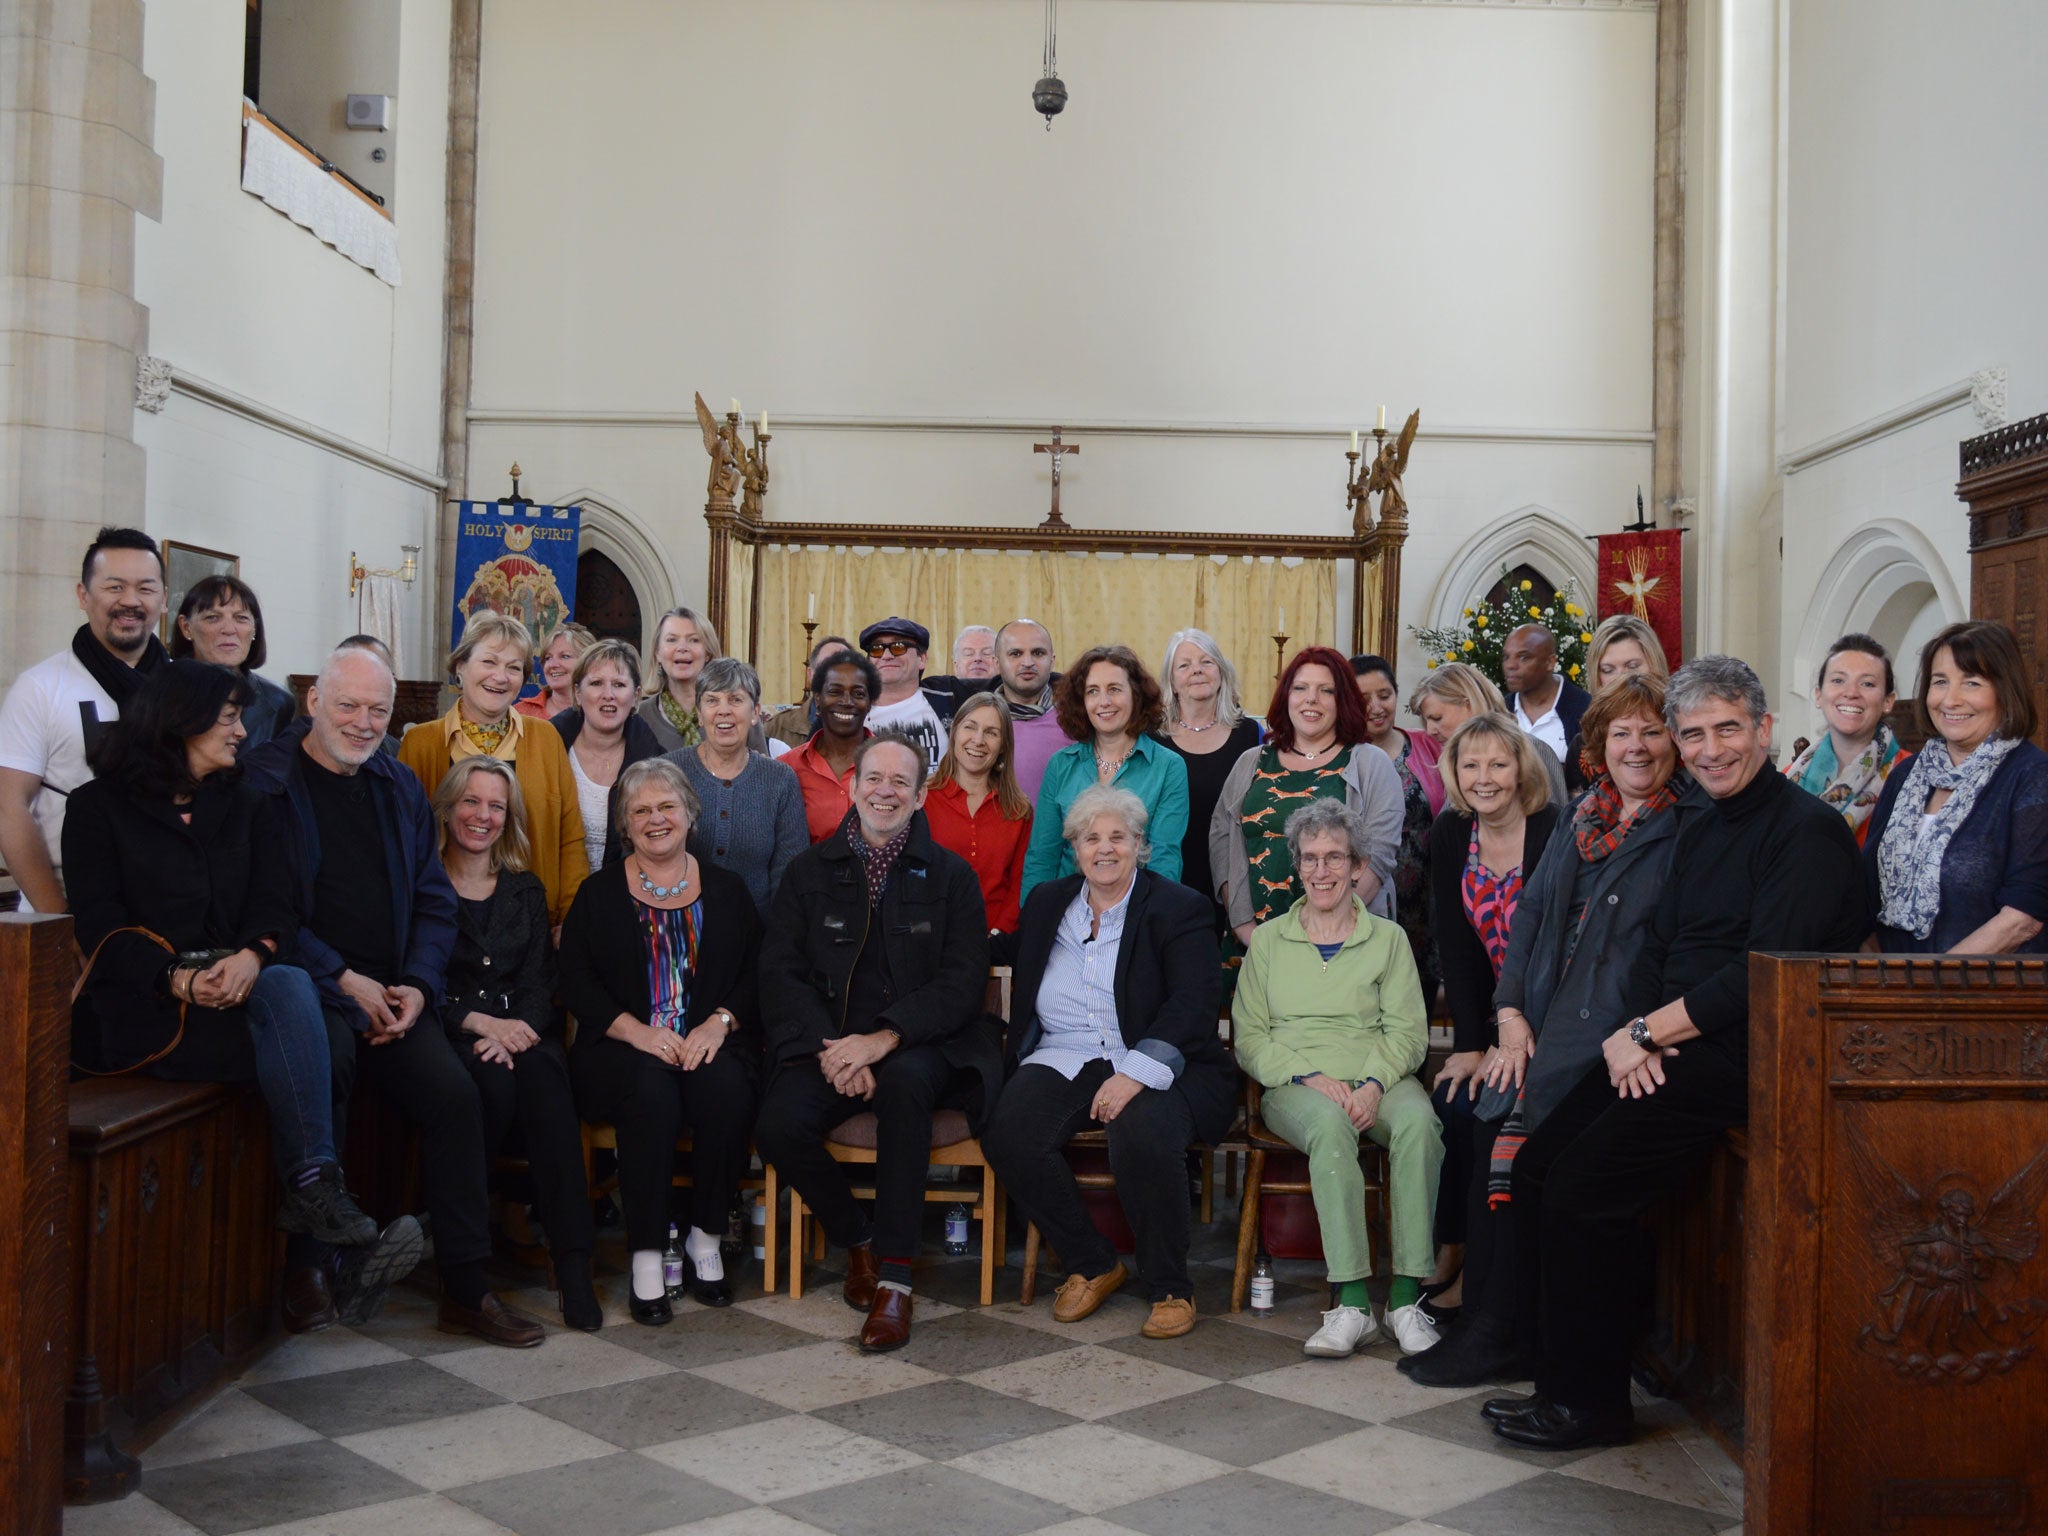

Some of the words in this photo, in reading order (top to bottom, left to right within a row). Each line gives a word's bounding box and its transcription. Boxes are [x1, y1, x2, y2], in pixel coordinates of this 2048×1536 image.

[464, 523, 504, 537] HOLY
[533, 527, 574, 541] SPIRIT
[1612, 551, 1623, 564] M
[1655, 547, 1667, 560] U
